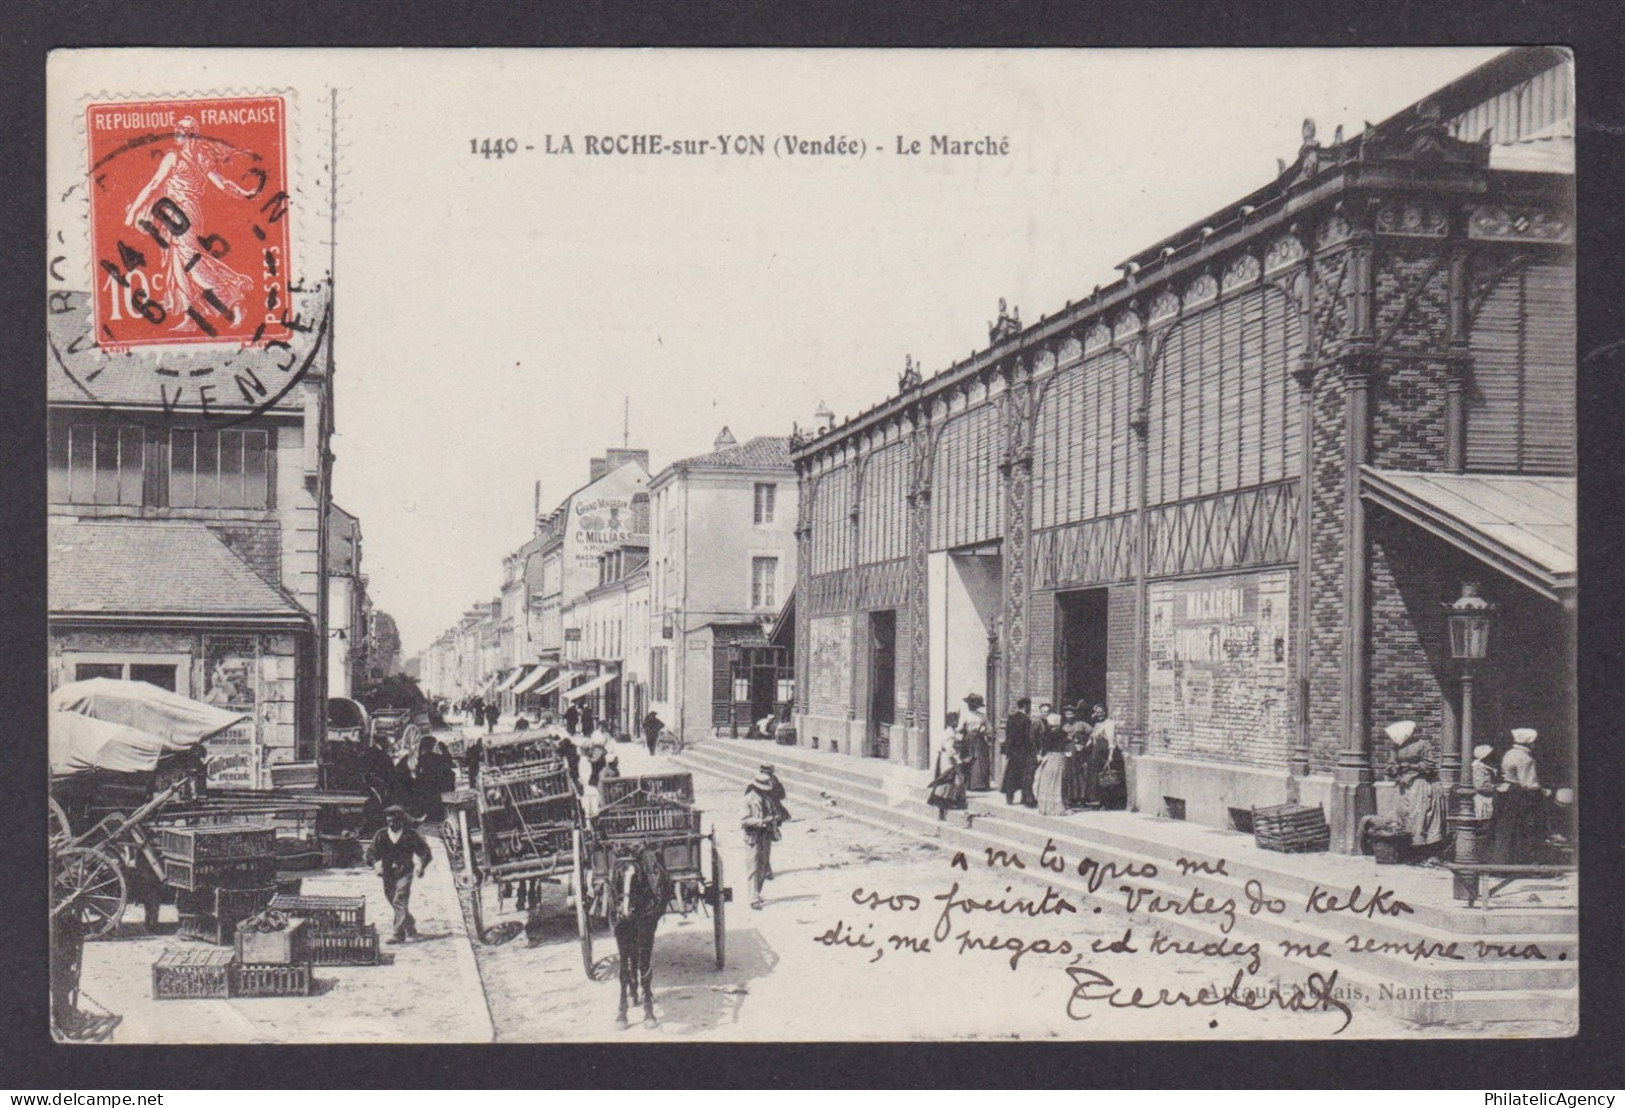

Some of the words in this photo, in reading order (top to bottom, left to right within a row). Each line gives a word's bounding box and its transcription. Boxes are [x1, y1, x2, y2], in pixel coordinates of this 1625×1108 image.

[95, 111, 176, 130] REPUBLIQUE
[200, 107, 276, 127] FRANÇAISE
[469, 137, 518, 160] 1440
[545, 135, 574, 155] LA
[584, 135, 766, 156] ROCHE-sur-YON
[773, 135, 867, 157] (Vendée)
[896, 135, 921, 155] Le
[930, 134, 1009, 156] Marché
[1377, 982, 1455, 1003] Nantes
